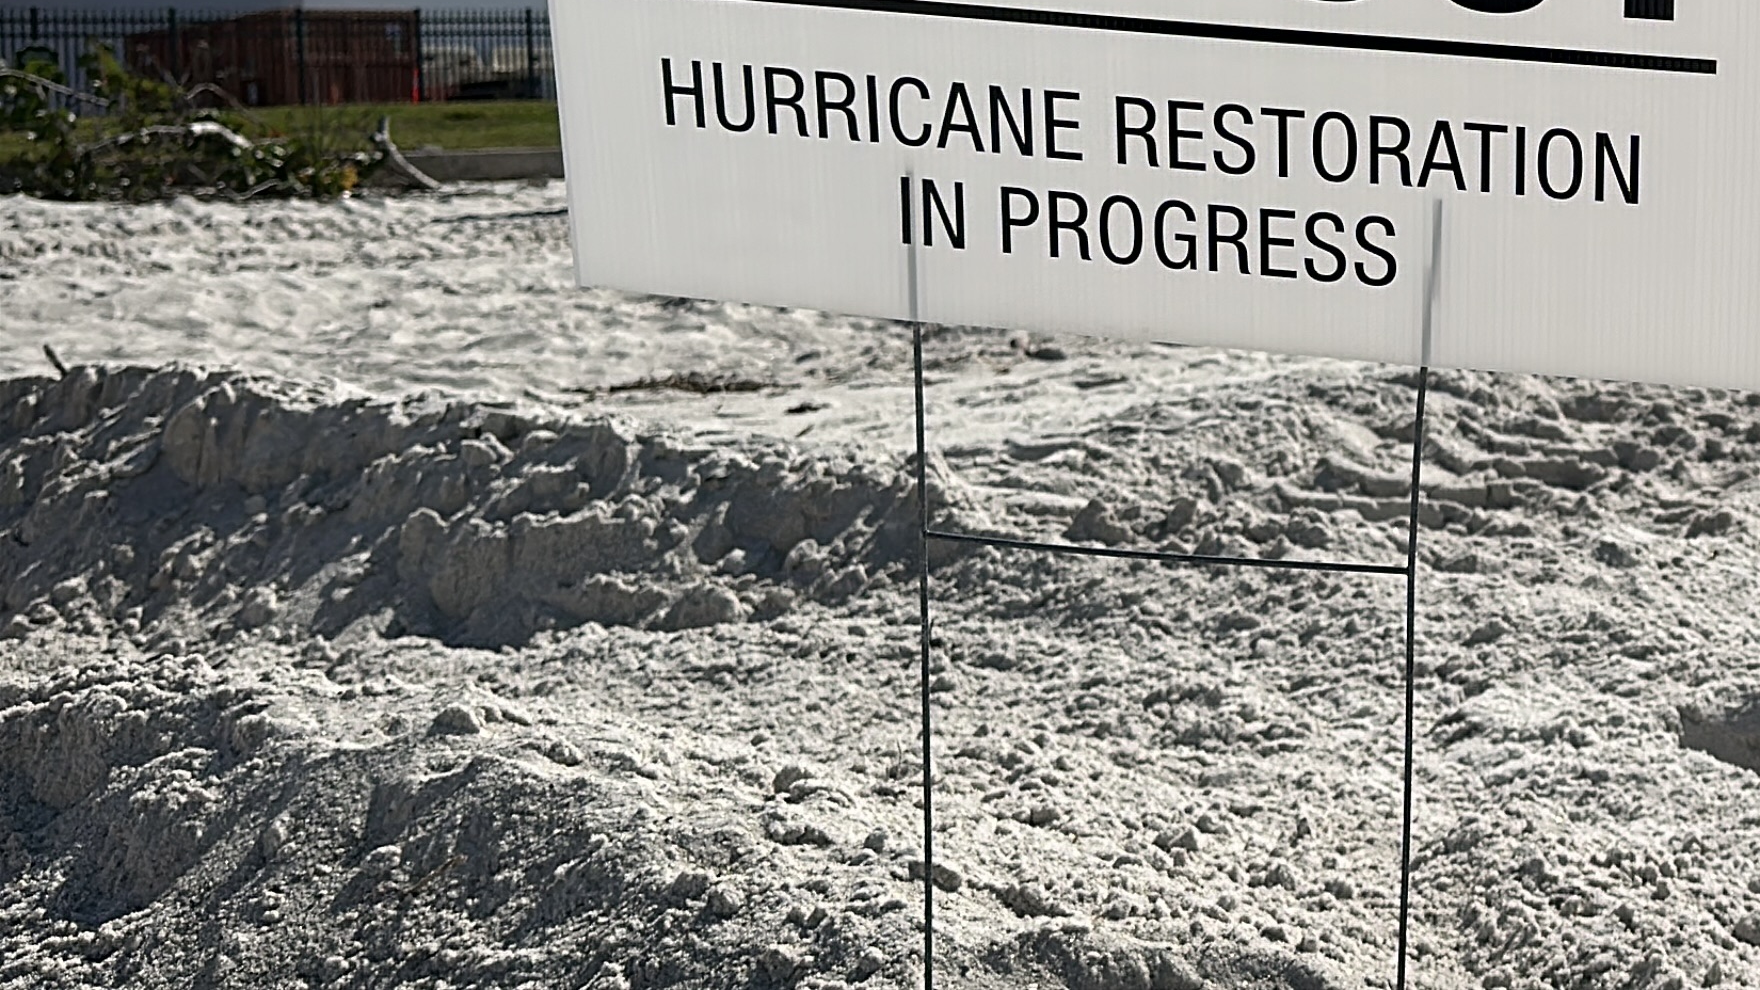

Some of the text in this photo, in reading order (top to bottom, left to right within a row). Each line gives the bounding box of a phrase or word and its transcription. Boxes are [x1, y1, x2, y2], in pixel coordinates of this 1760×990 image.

[661, 57, 1640, 205] HURRICANE RESTORATION
[900, 176, 1397, 287] IN PROGRESS
